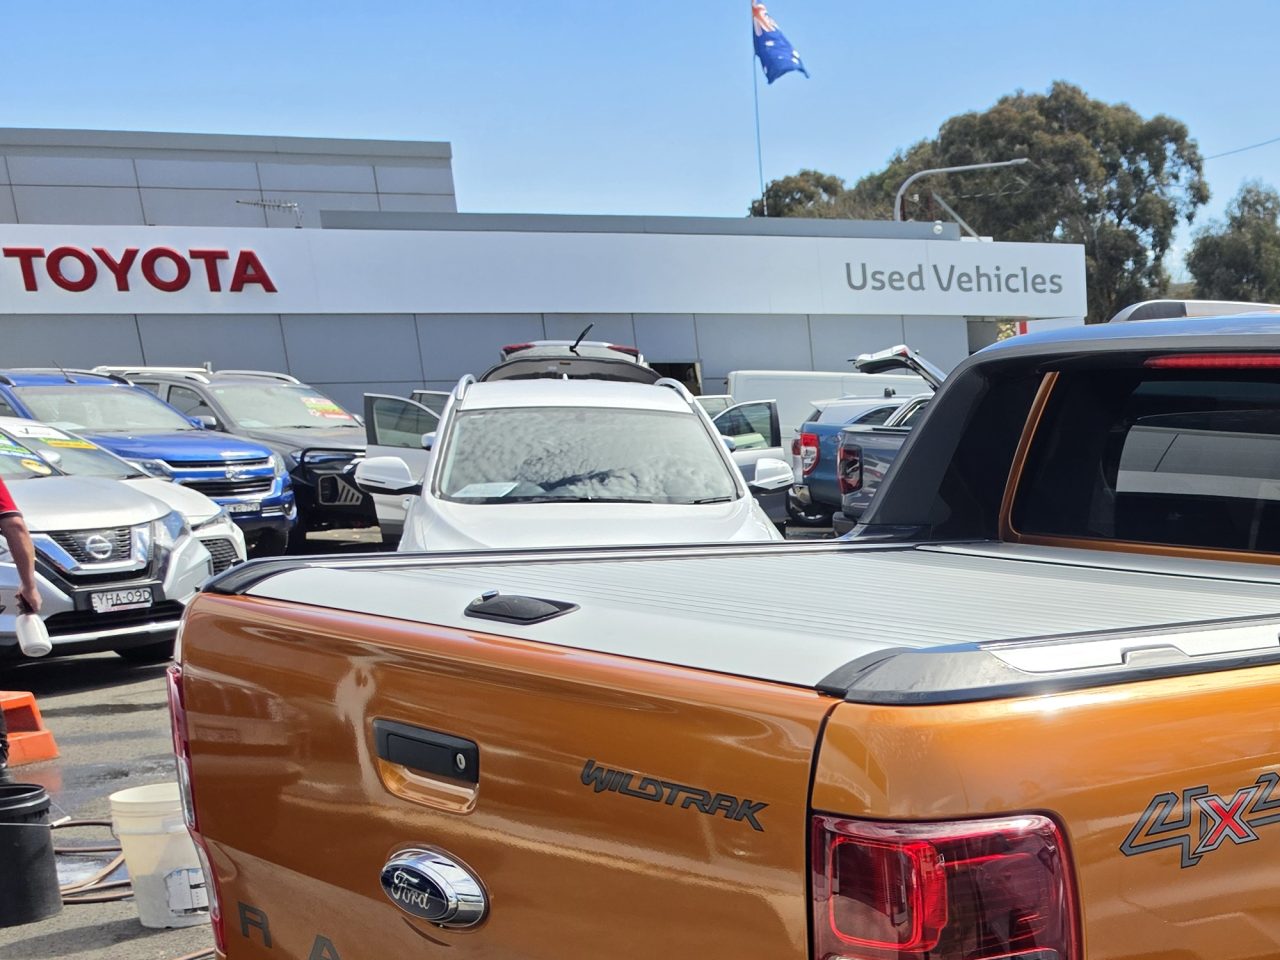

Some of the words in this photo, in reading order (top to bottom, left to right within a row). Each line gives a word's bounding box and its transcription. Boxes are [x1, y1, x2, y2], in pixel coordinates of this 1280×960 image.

[2, 246, 278, 292] TOYOTA
[845, 262, 926, 291] Used
[932, 264, 1063, 294] Vehicles
[580, 759, 770, 832] WILDTRAK
[391, 870, 430, 910] Ford
